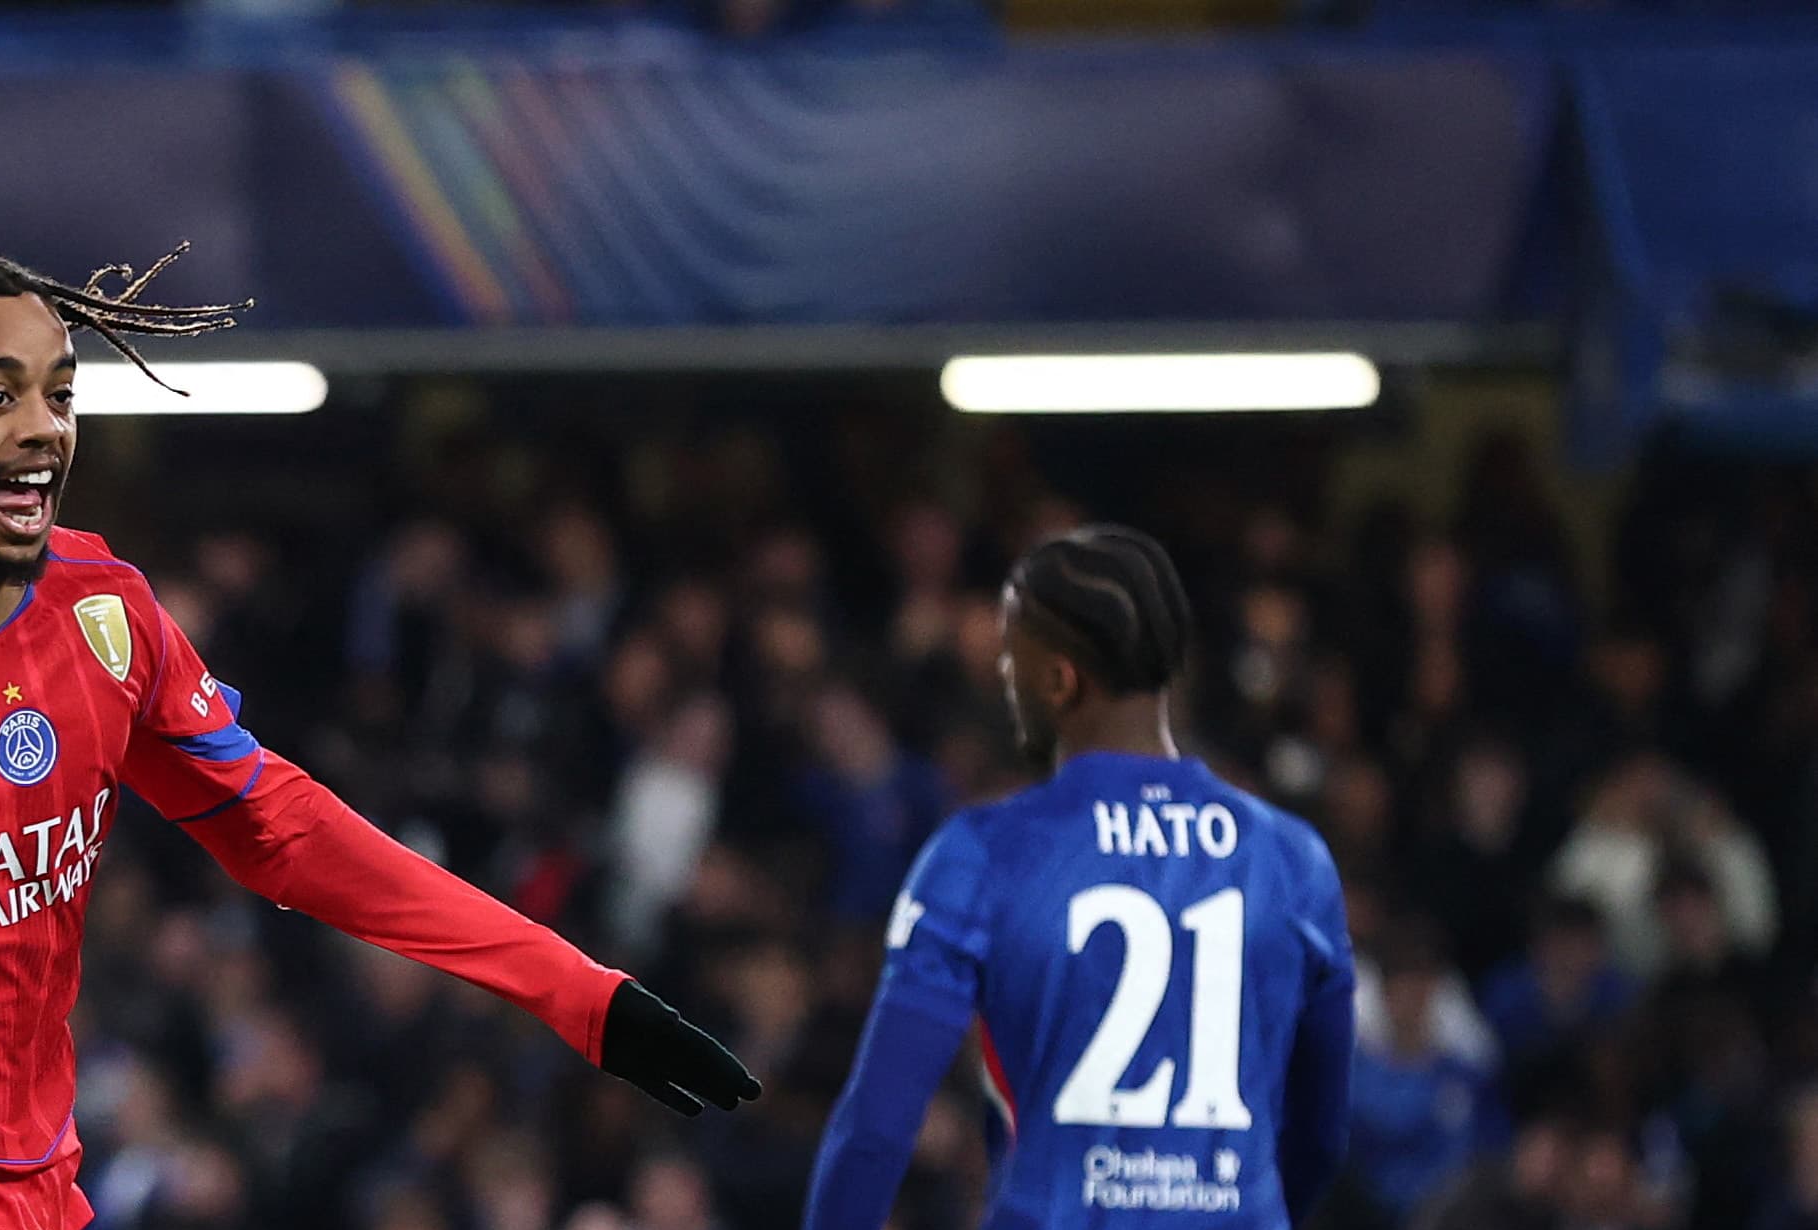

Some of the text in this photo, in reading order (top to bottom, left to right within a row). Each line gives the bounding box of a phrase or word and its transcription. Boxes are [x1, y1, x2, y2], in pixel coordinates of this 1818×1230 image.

[2, 714, 42, 737] PARIS
[1093, 799, 1239, 859] HATO
[1053, 884, 1252, 1130] 21
